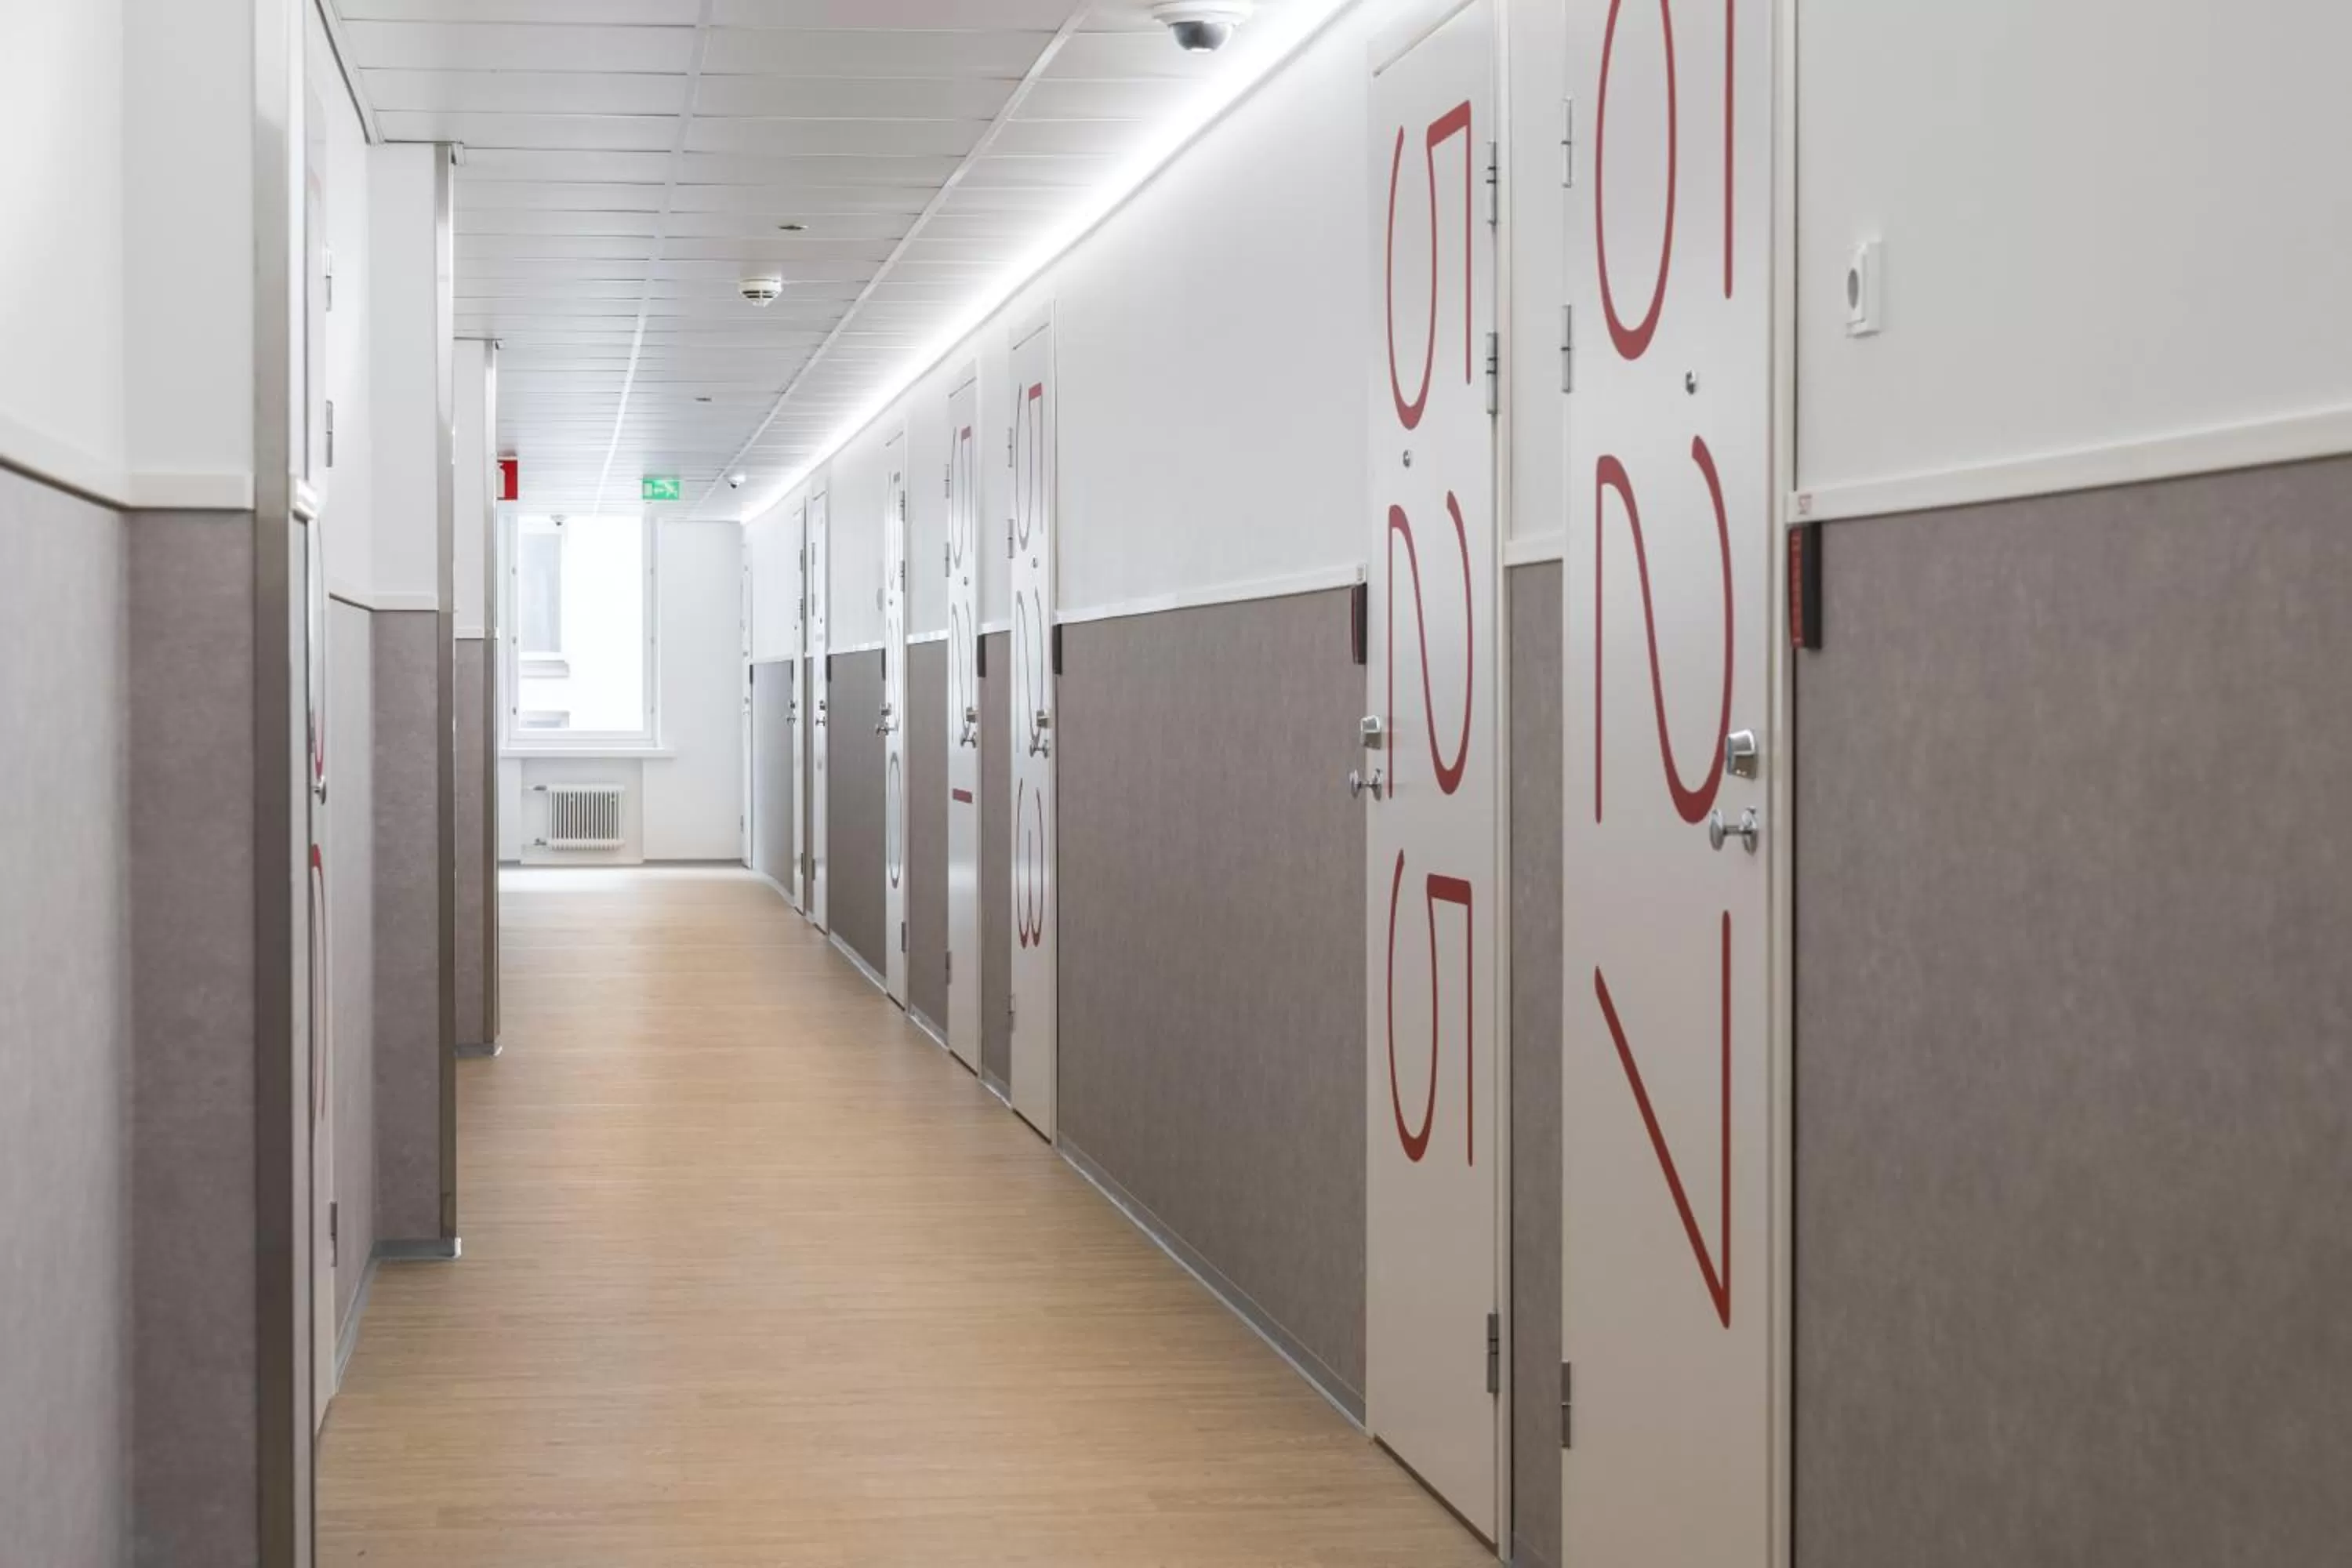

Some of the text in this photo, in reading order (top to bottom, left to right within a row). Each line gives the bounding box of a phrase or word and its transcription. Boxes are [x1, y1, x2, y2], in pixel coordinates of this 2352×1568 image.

[1015, 382, 1044, 949] 523
[1386, 100, 1474, 1167] 525
[1595, 0, 1735, 1329] 527
